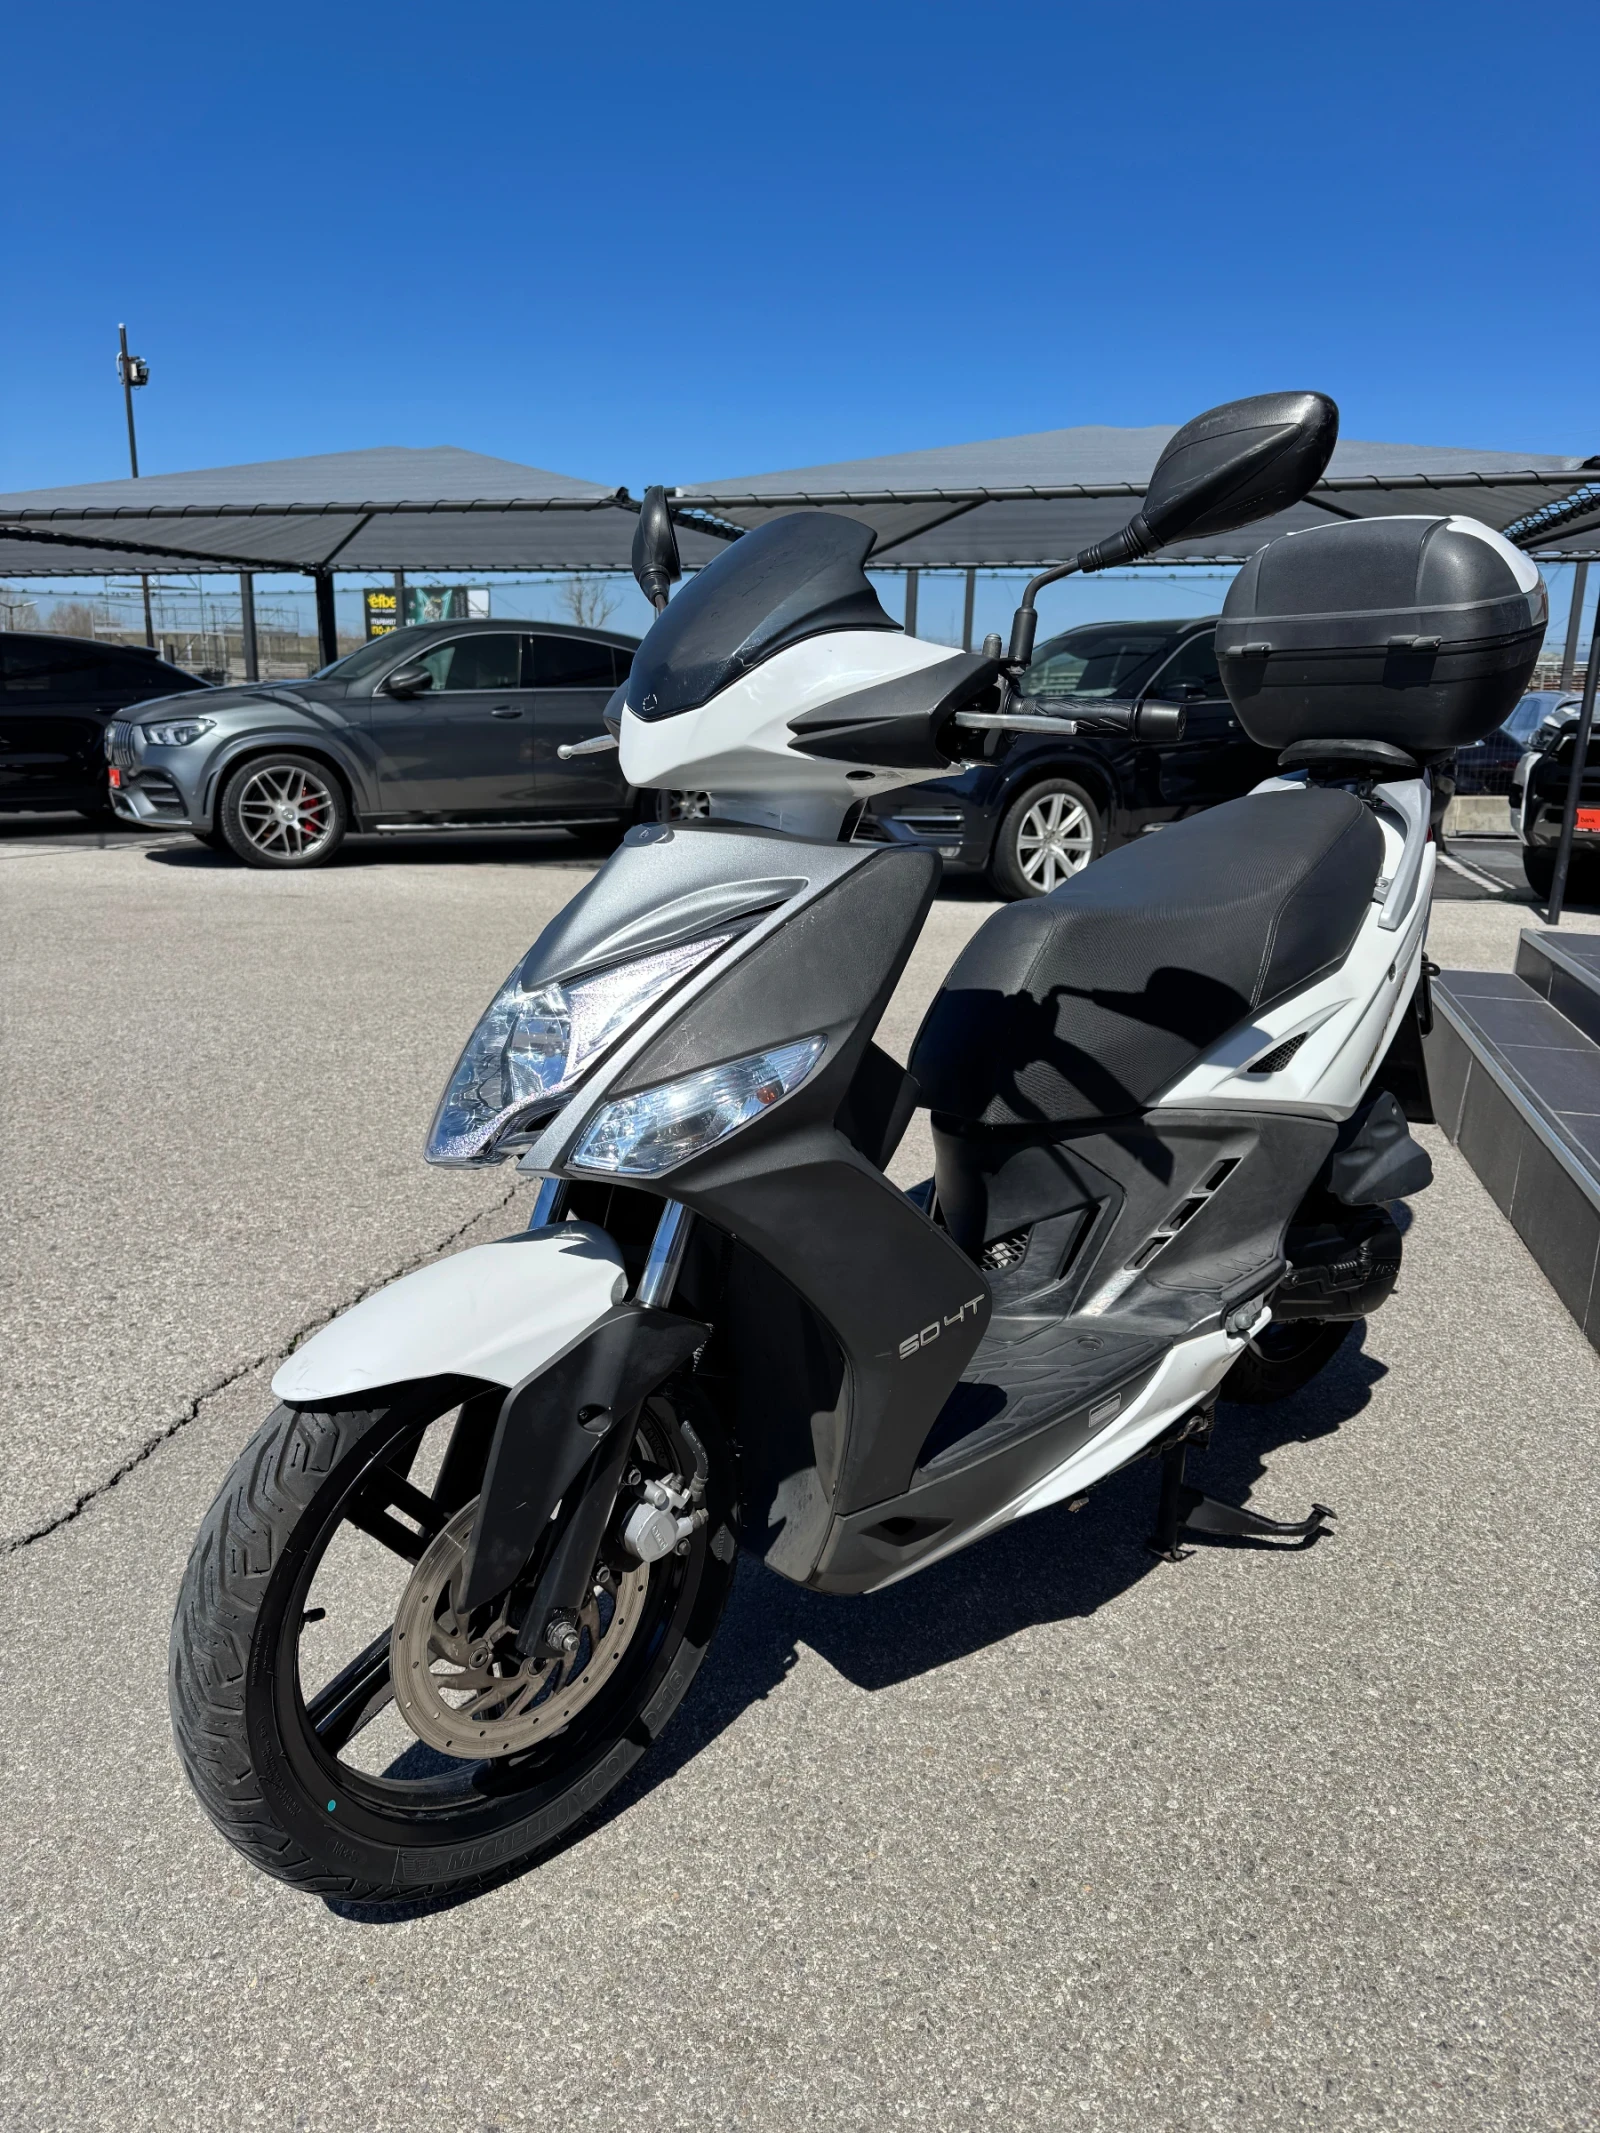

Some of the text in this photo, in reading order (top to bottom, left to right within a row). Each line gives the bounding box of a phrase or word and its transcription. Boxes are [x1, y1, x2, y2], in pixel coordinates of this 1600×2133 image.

[898, 1293, 985, 1360] 50 4T
[446, 1799, 568, 1872] MICHELIN
